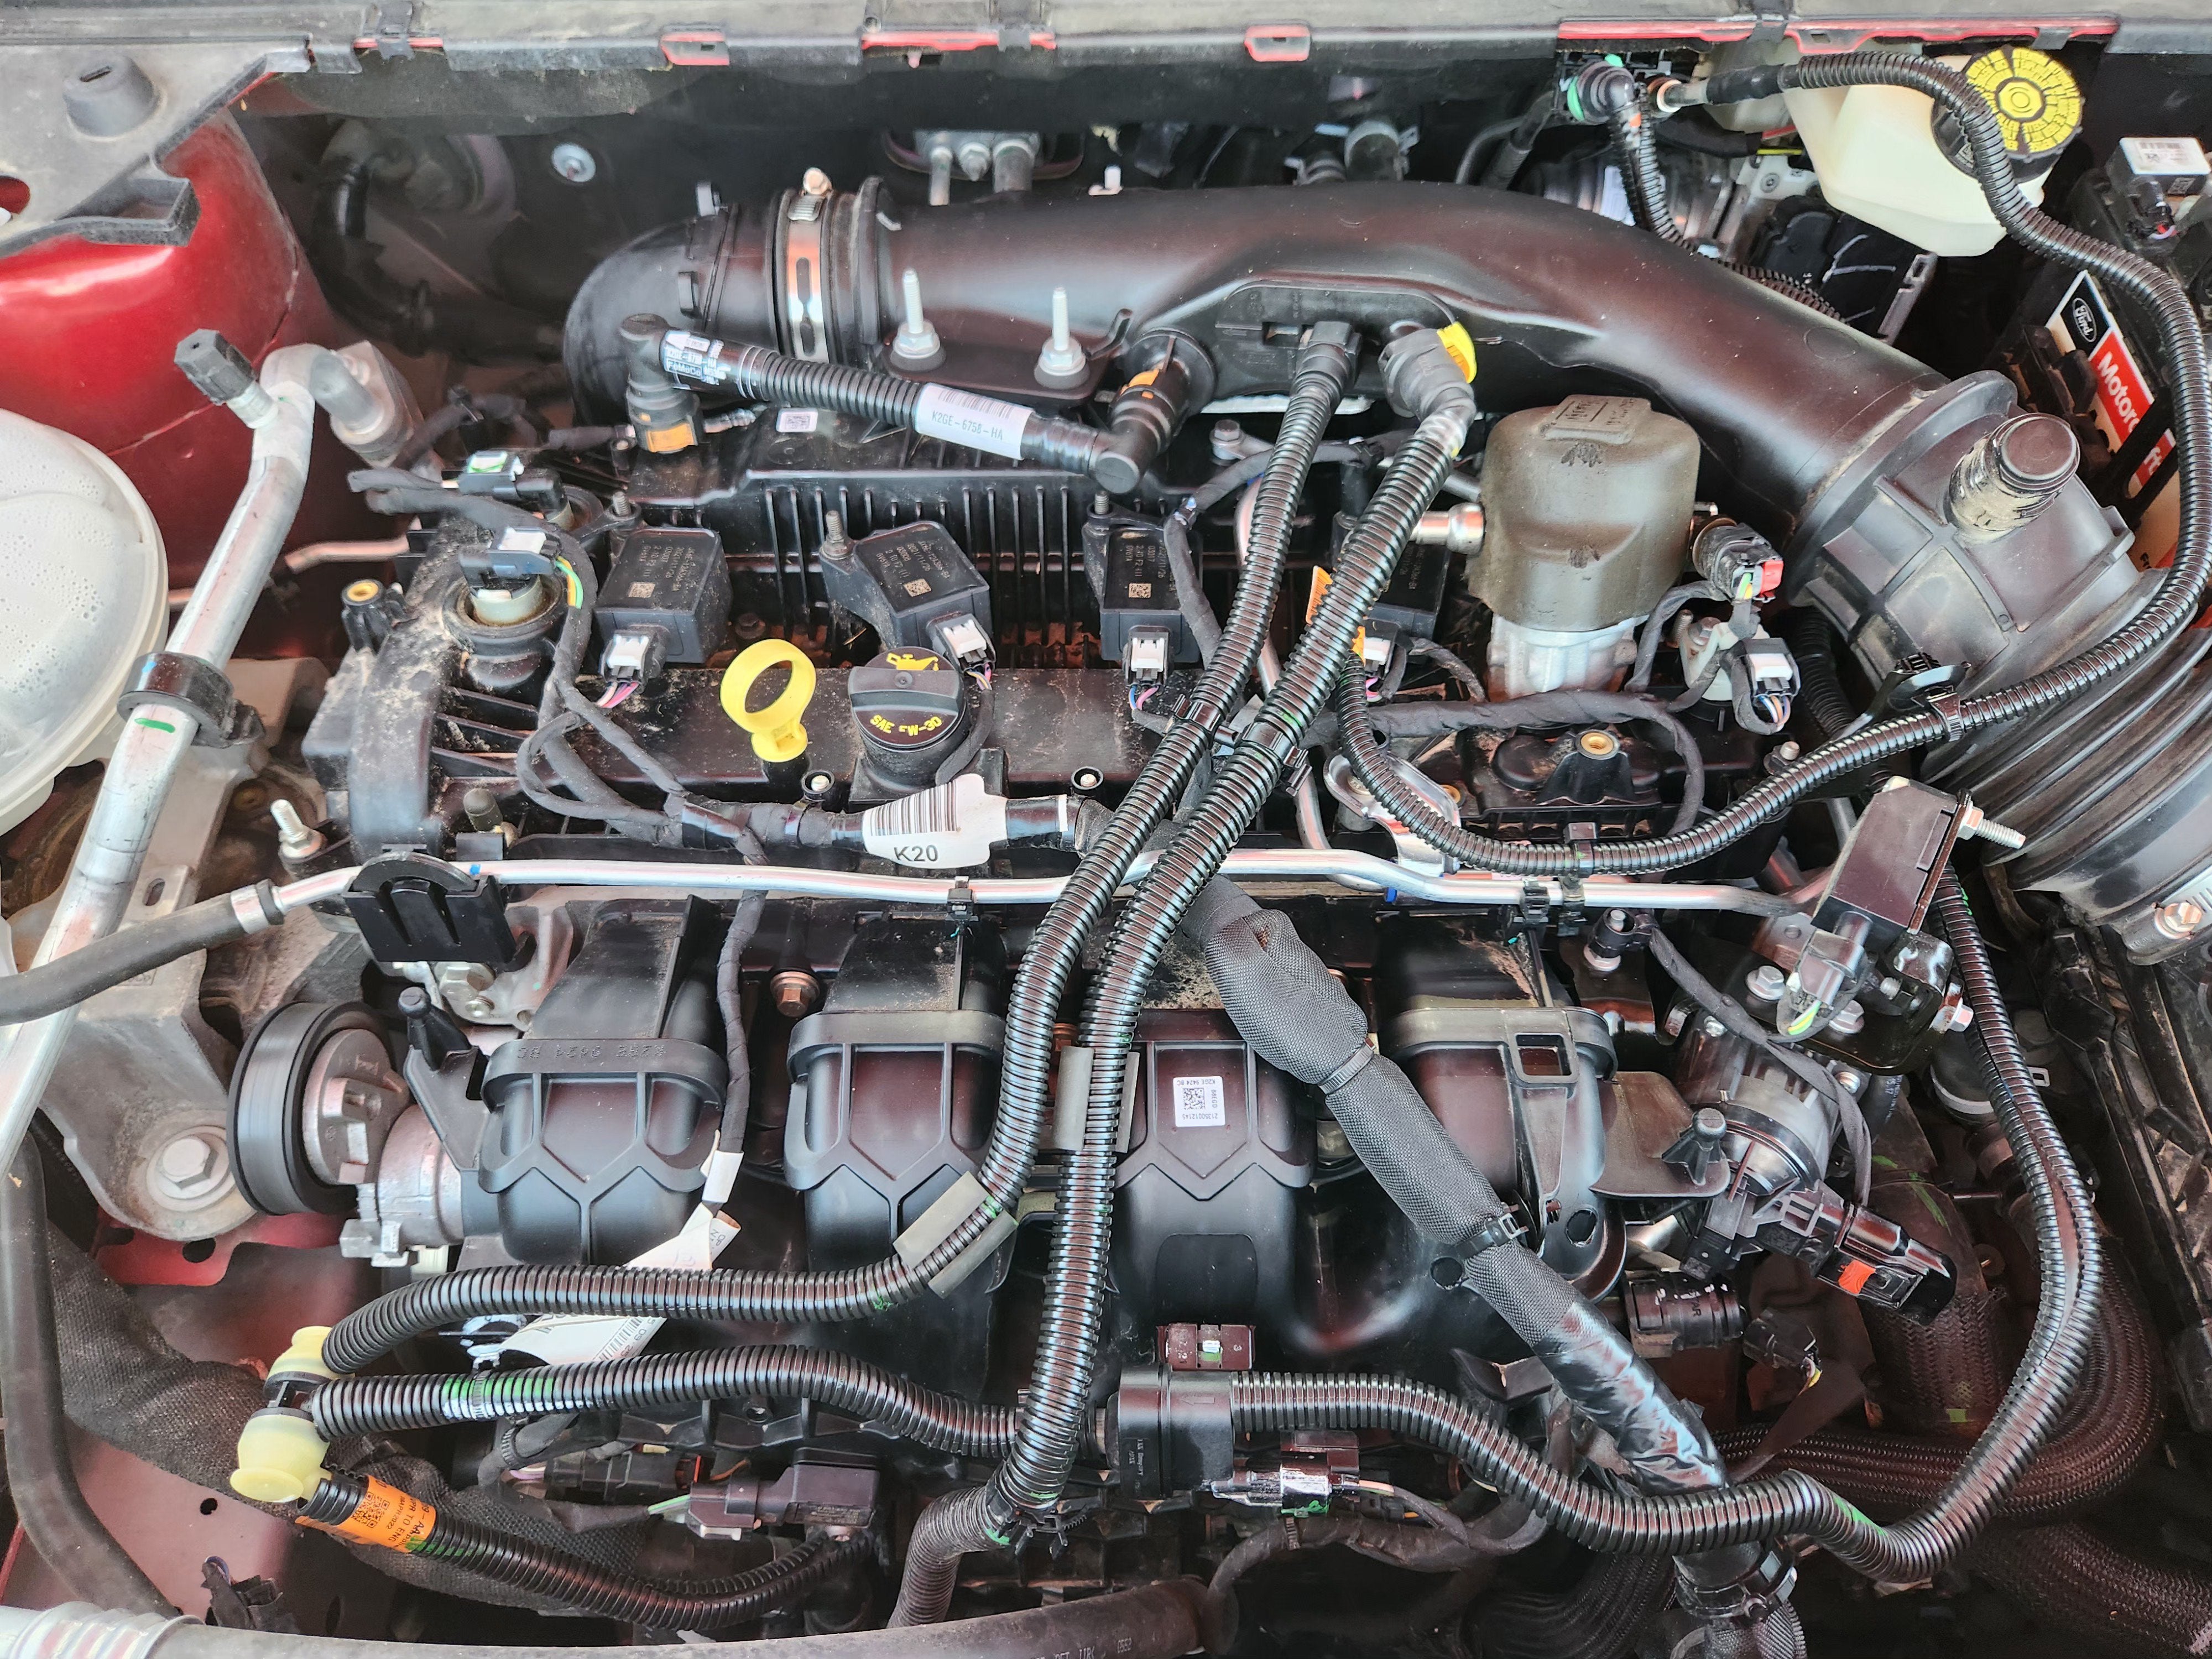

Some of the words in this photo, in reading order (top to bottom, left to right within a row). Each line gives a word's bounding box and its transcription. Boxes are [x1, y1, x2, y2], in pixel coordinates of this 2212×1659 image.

[2075, 304, 2094, 336] Ford
[667, 360, 701, 376] FoMoCo
[869, 714, 895, 734] SAE
[894, 844, 938, 862] K20
[403, 1514, 414, 1525] TO
[388, 1527, 405, 1542] ENG
